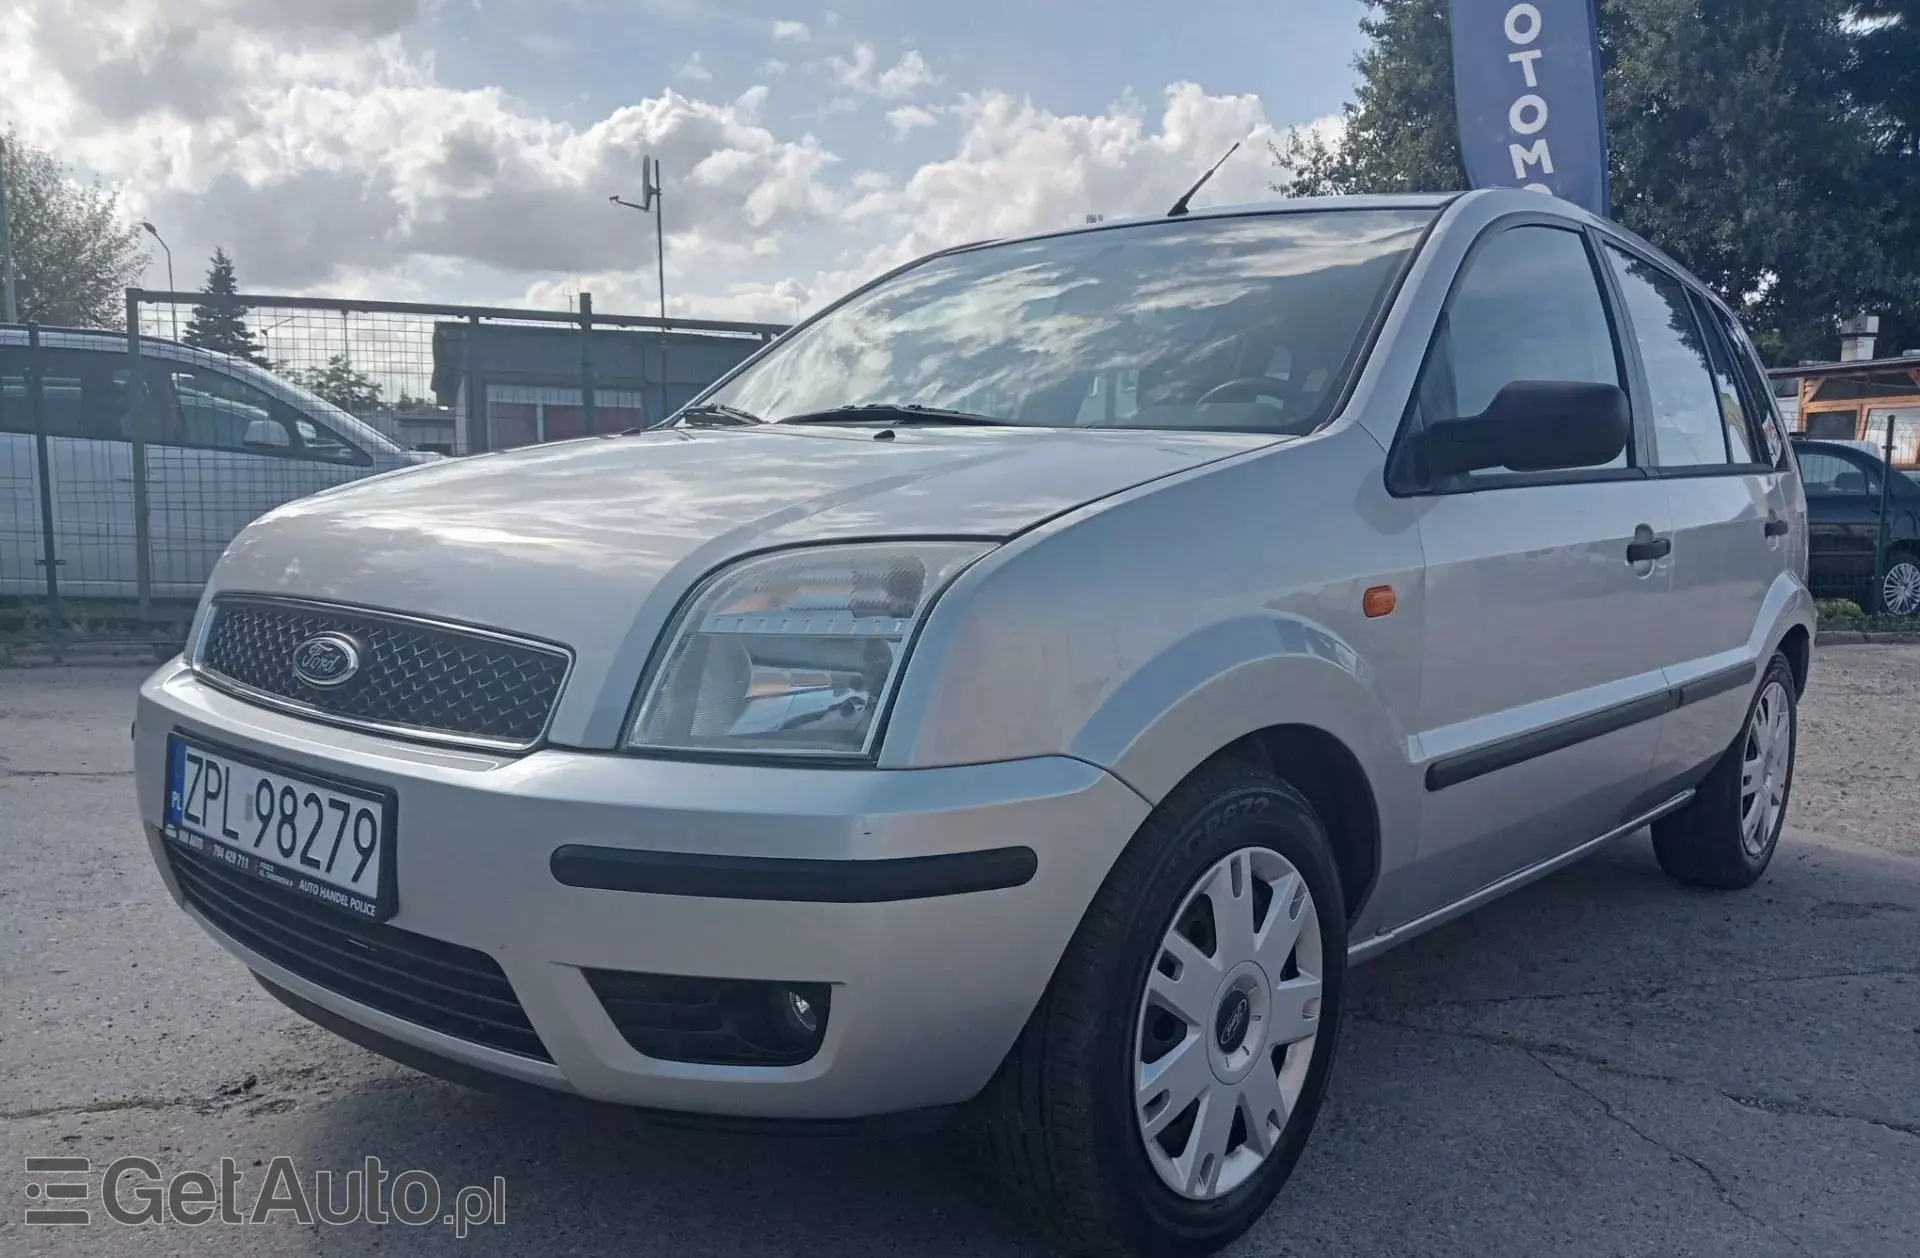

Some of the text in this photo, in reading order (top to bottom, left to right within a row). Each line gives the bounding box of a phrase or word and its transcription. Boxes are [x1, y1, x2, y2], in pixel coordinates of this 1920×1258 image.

[1504, 3, 1554, 195] OTOM
[172, 791, 182, 811] PL
[184, 753, 377, 883] ZPL 98279
[299, 880, 377, 917] AUTO HANDEL POLICE
